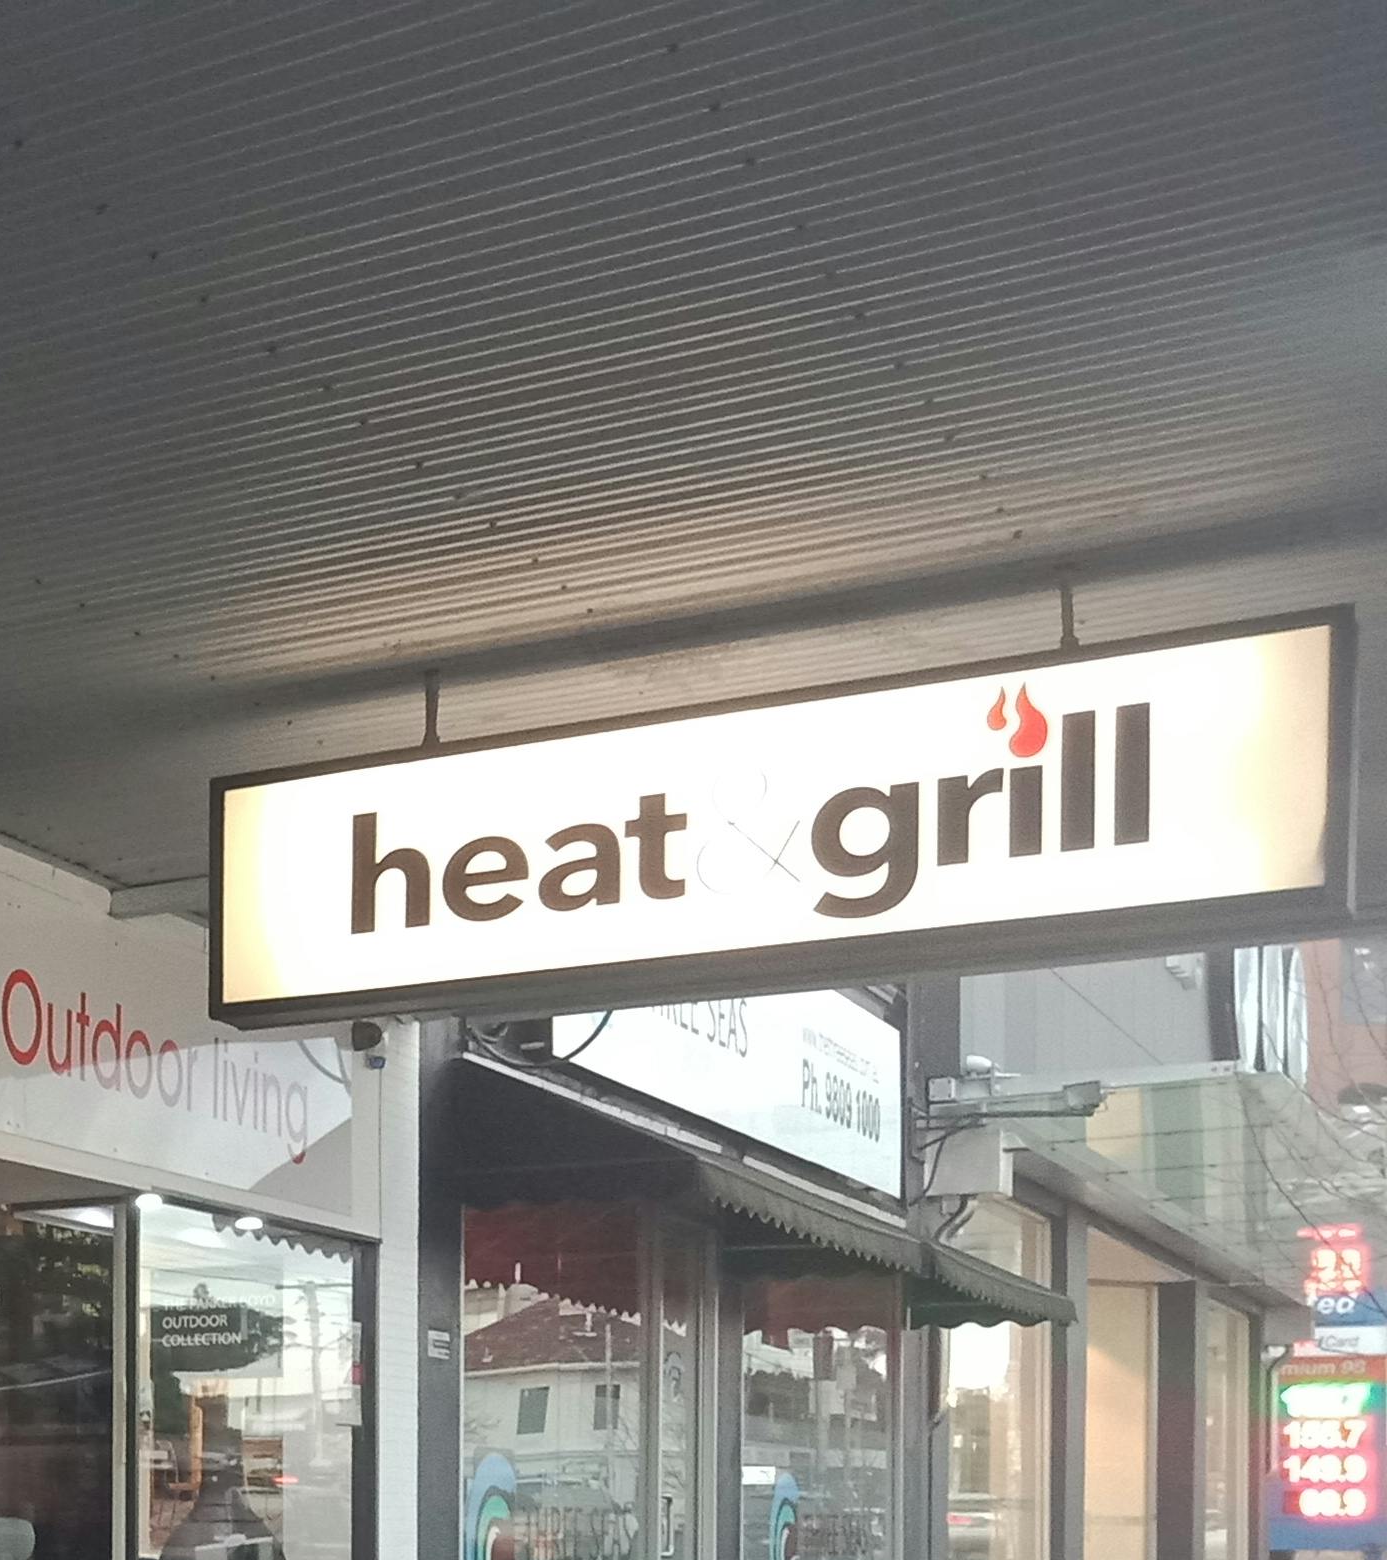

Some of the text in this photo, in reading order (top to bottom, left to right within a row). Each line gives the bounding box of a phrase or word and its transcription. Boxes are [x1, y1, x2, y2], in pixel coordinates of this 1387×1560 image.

[1, 967, 309, 1164] Outdoor living
[161, 1314, 229, 1330] OUTDOOR
[161, 1331, 243, 1348] COLLECTION
